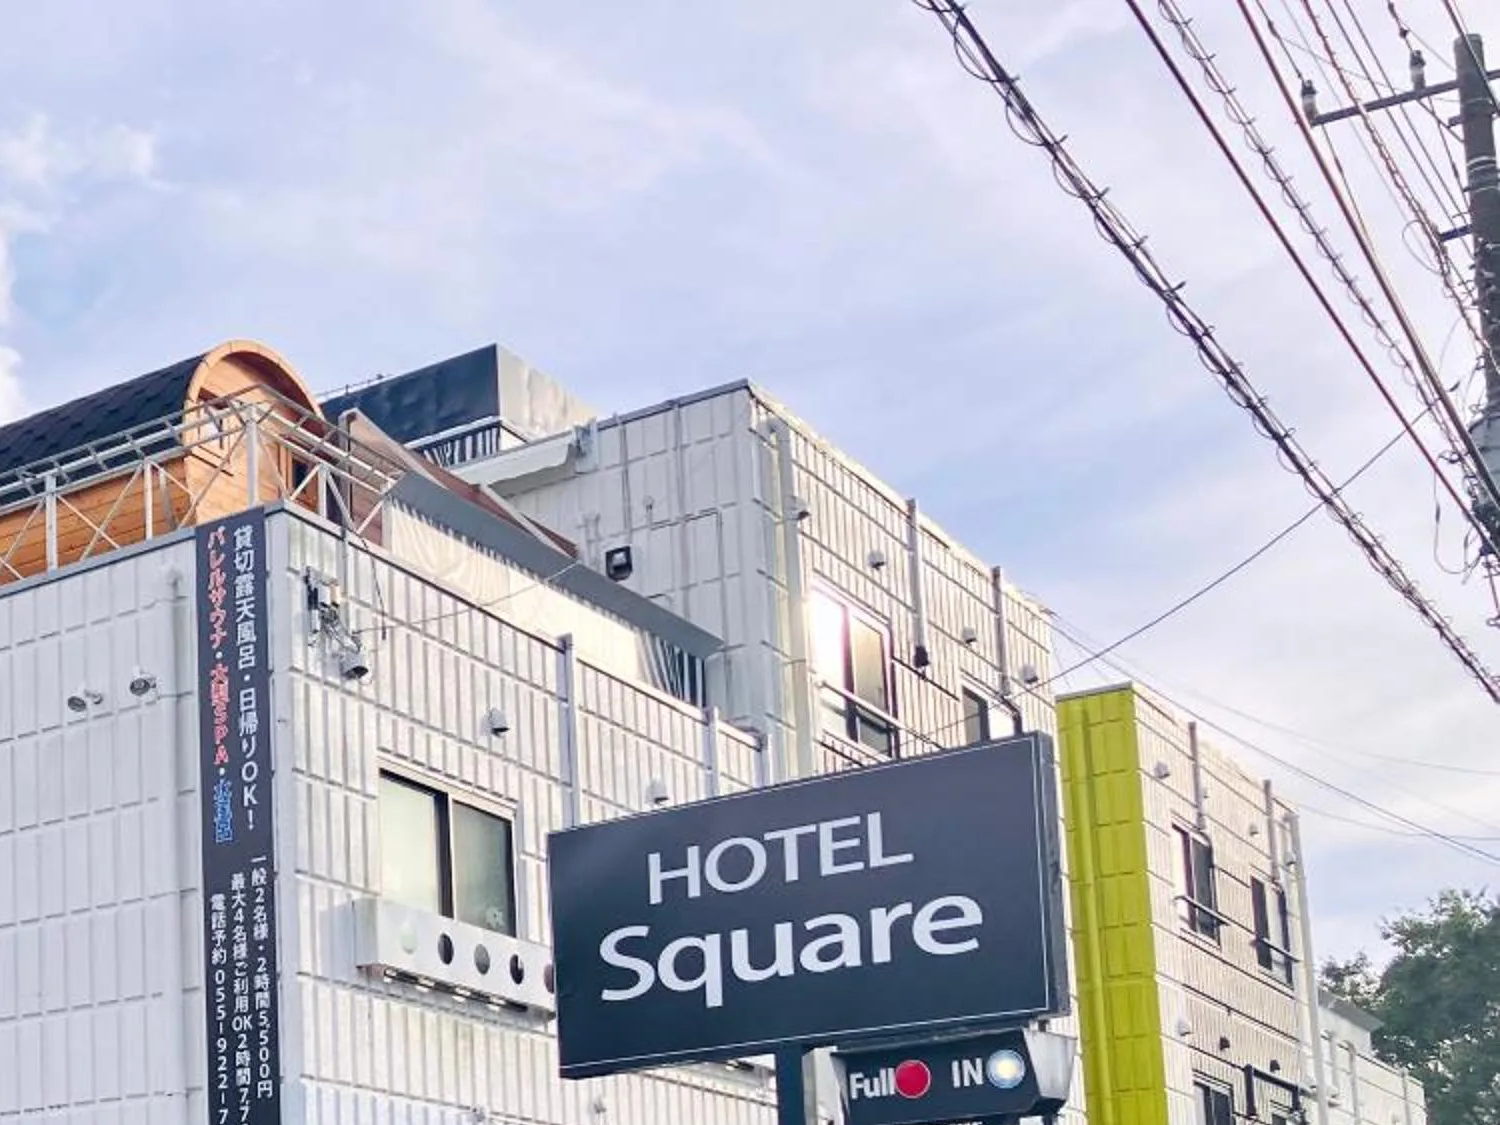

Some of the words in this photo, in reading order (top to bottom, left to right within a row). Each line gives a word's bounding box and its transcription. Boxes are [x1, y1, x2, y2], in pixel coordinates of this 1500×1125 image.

[648, 812, 914, 904] HOTEL
[600, 895, 982, 1008] Square
[850, 1067, 897, 1099] Full
[951, 1057, 985, 1089] IN
